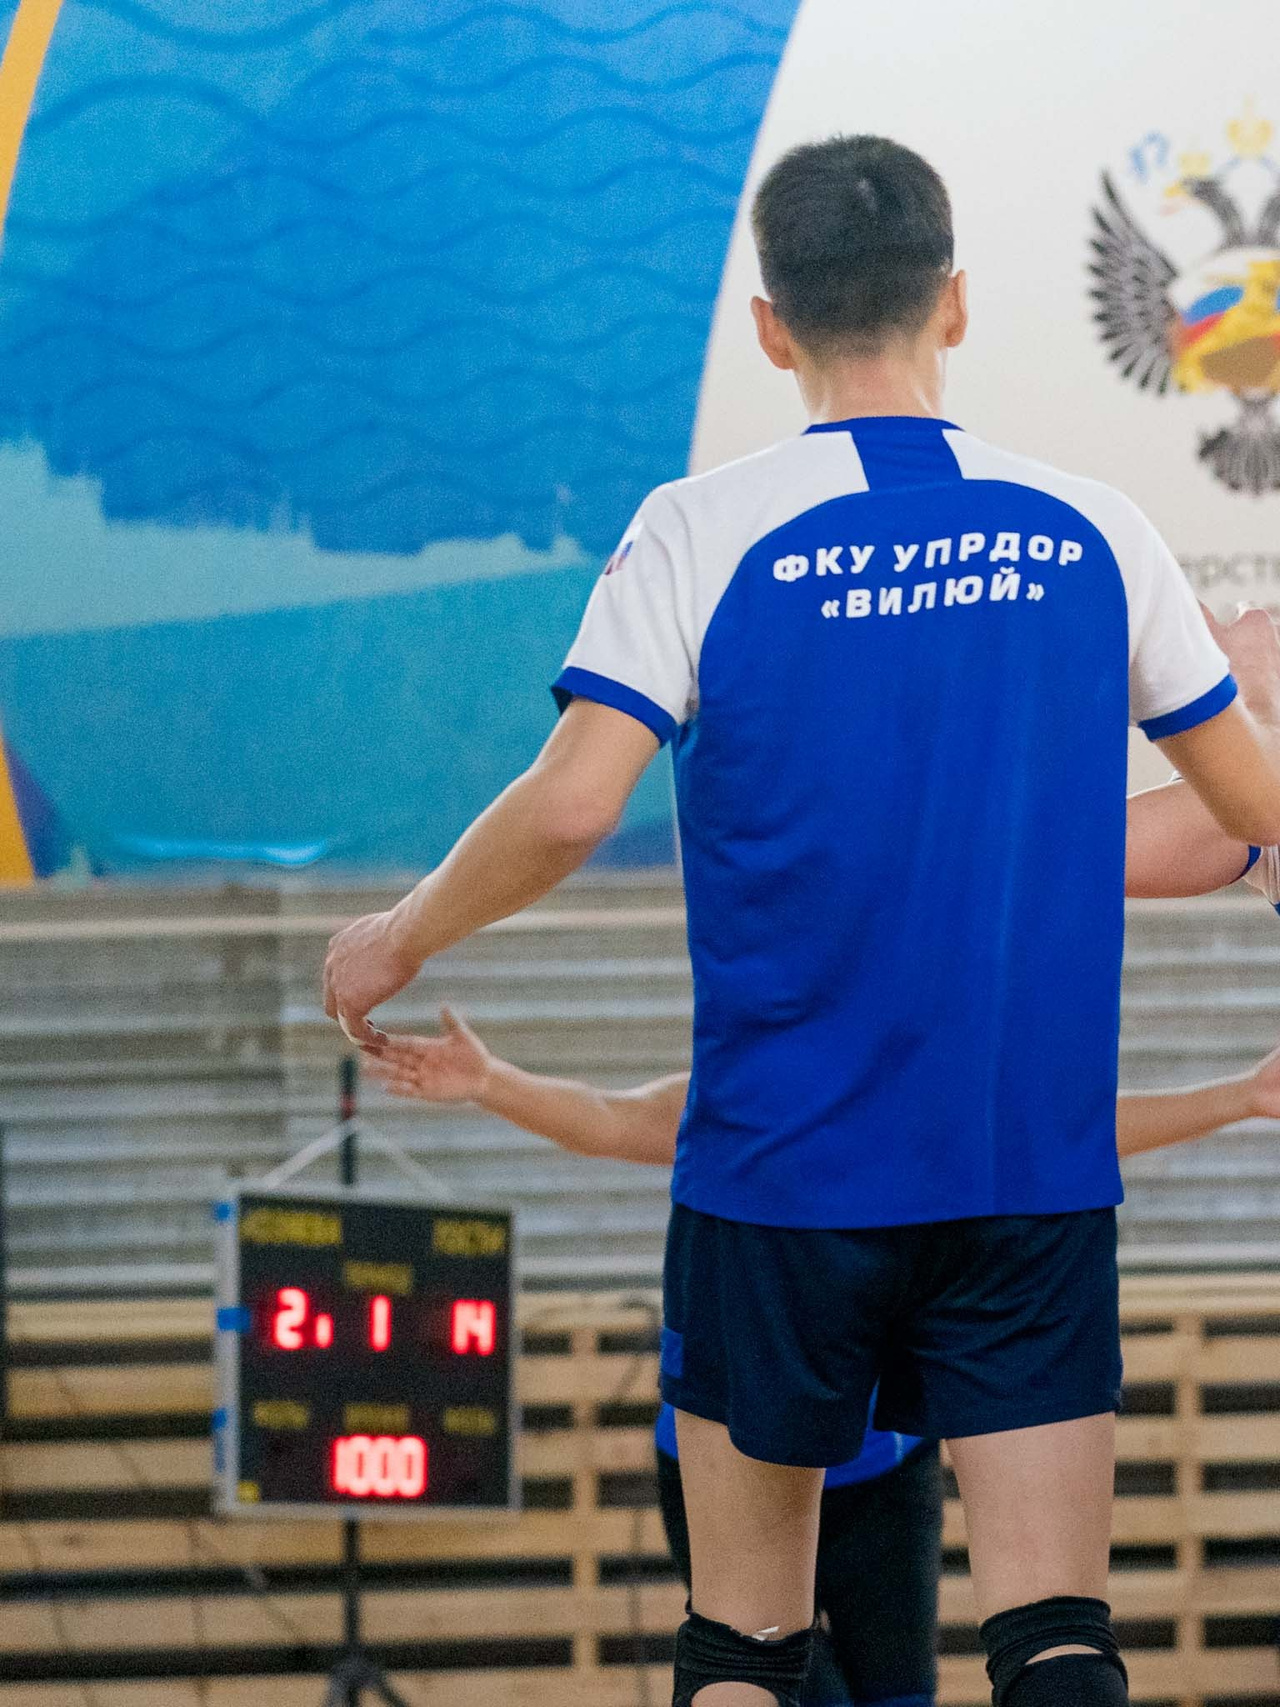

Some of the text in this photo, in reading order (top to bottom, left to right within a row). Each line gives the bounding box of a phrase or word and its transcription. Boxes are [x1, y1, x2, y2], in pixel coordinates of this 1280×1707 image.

[773, 532, 1083, 582] ФКУ УПРДОР
[820, 567, 1045, 619] «ВИЛЮЙ»
[371, 1295, 391, 1352] 1
